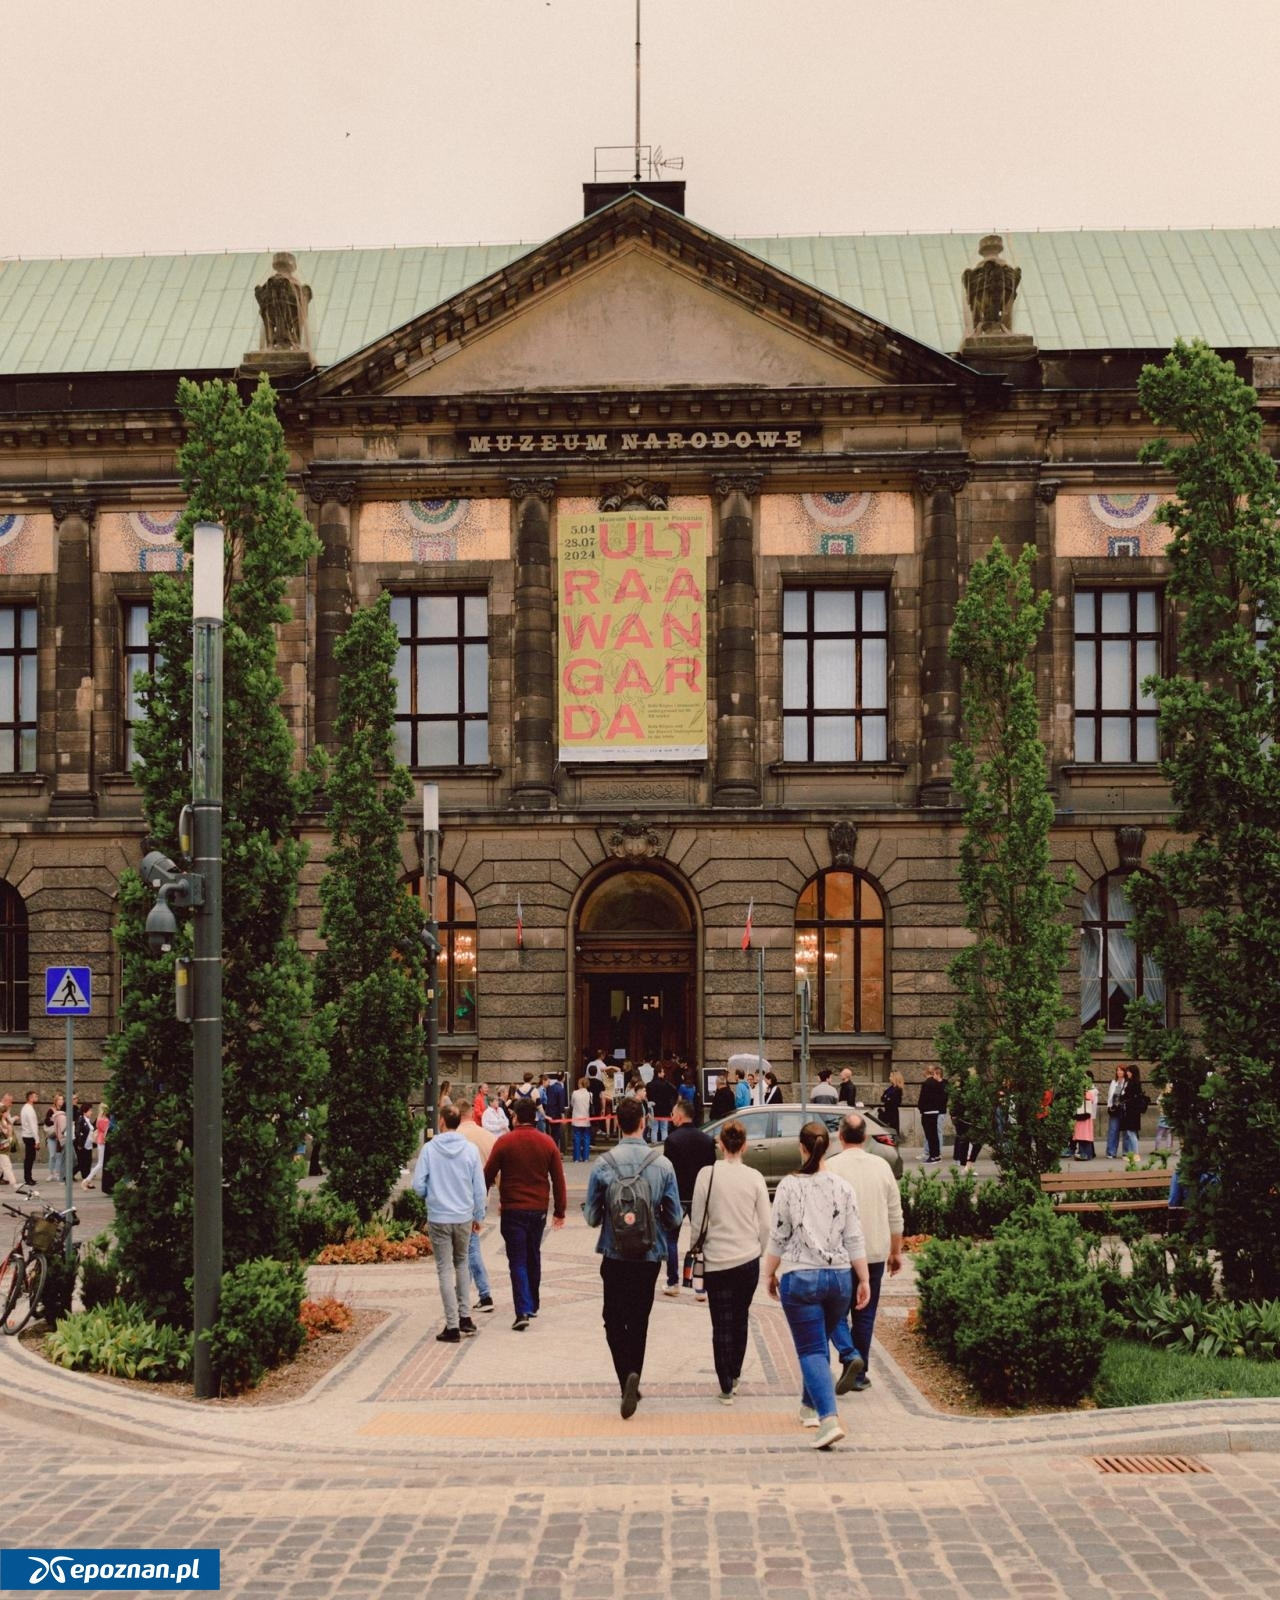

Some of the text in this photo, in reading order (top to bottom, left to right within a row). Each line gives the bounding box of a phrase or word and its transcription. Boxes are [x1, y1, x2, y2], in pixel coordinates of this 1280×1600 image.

[469, 431, 802, 453] MUZEUM NARODOWE
[571, 524, 595, 535] 5.04
[599, 522, 703, 560] ULT
[564, 550, 595, 561] 2024
[563, 567, 703, 605] RAA
[562, 612, 702, 651] WAN
[562, 657, 703, 697] GAR
[563, 704, 646, 741] DA
